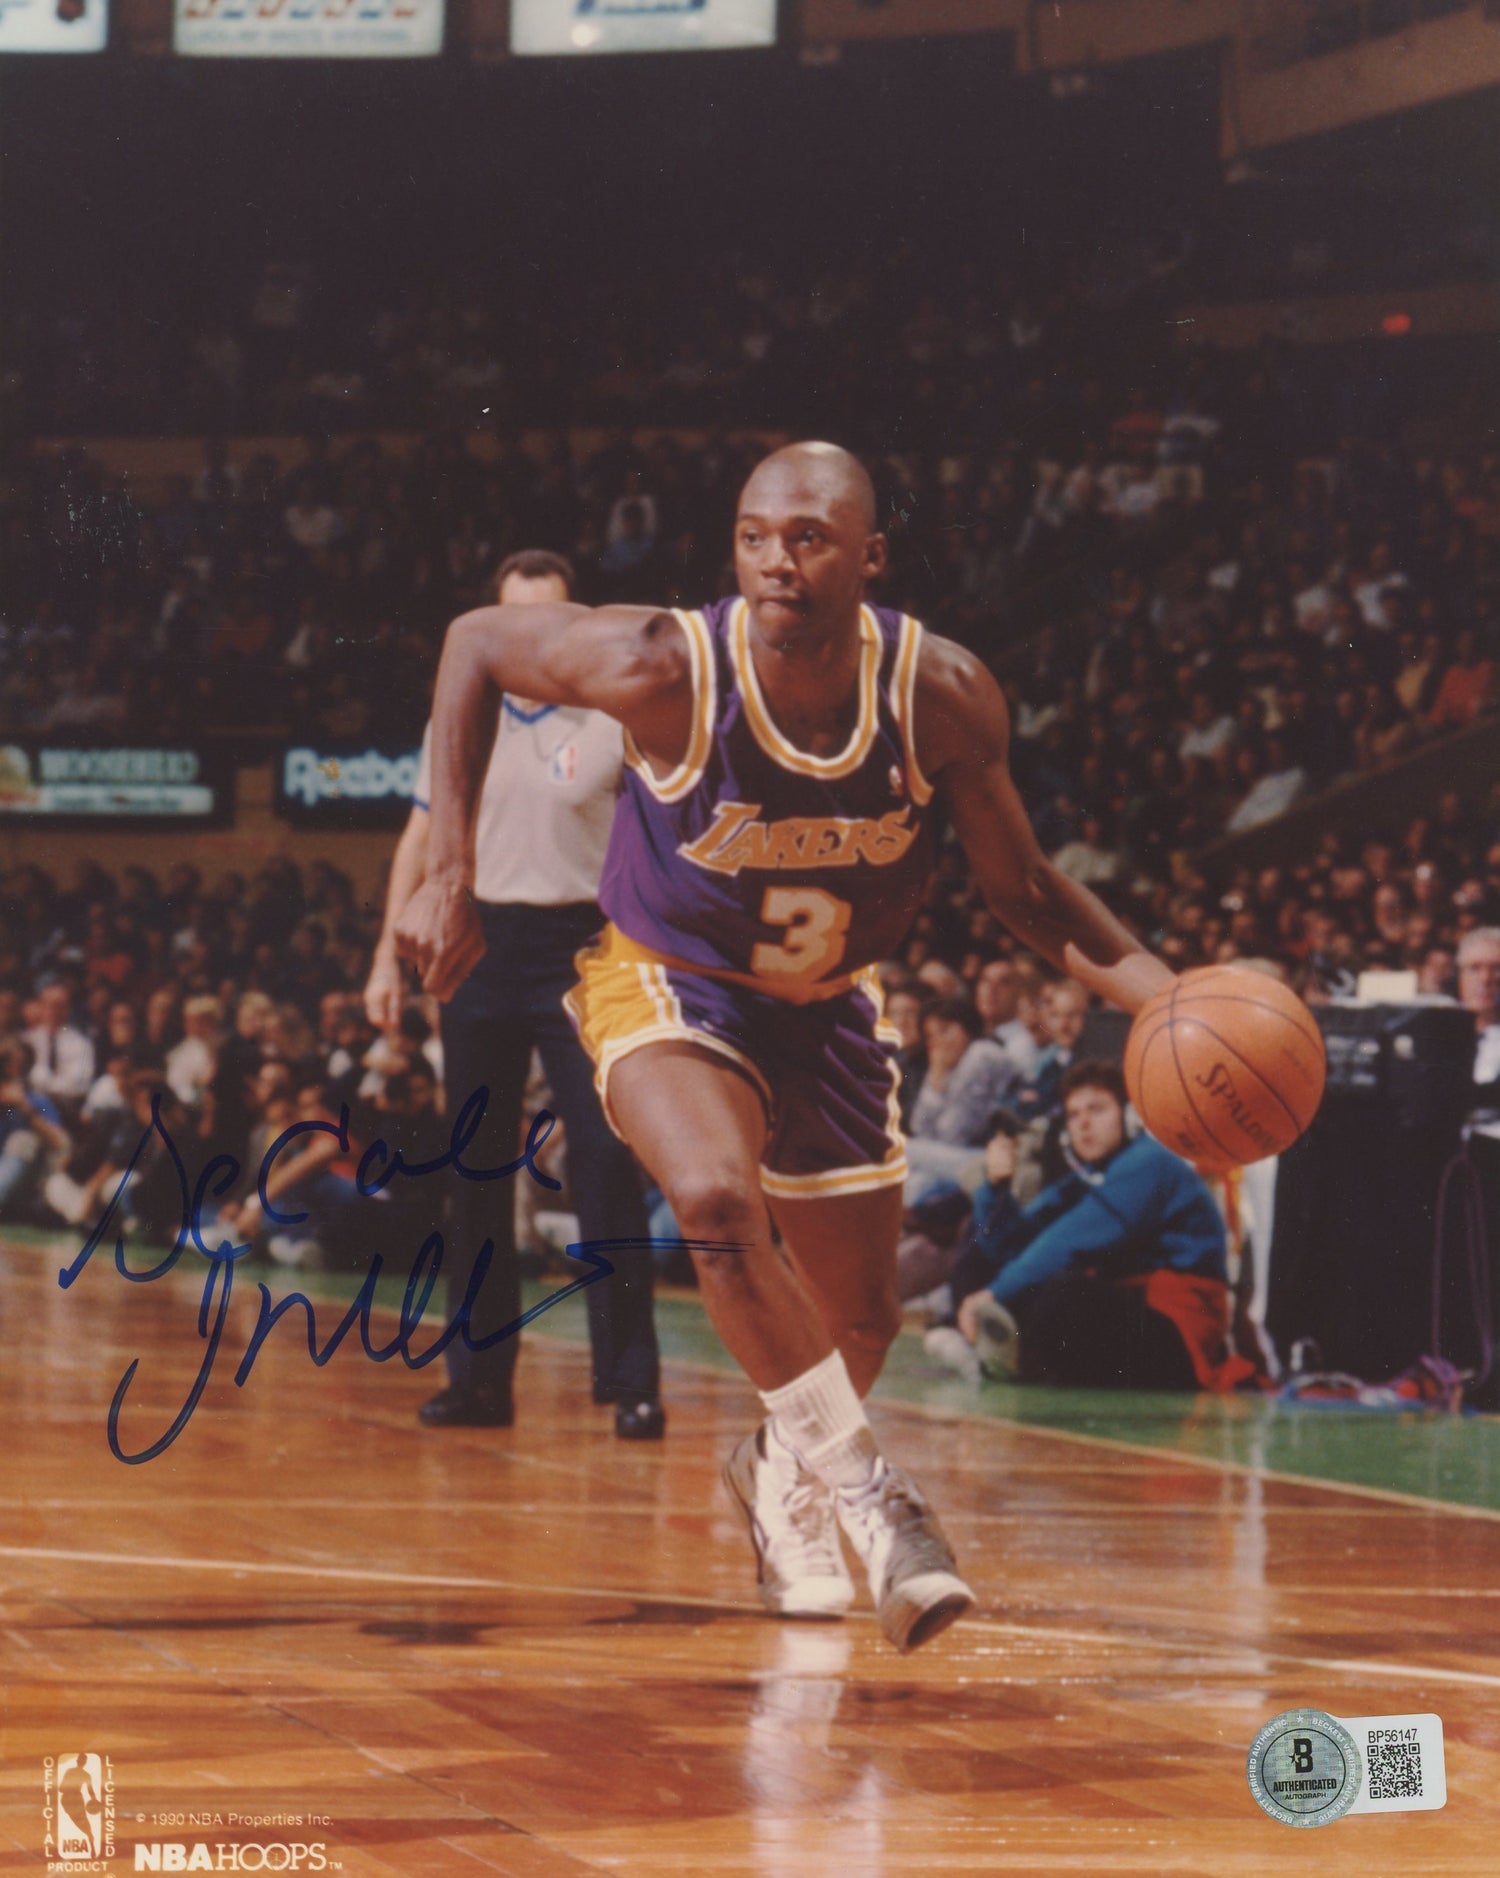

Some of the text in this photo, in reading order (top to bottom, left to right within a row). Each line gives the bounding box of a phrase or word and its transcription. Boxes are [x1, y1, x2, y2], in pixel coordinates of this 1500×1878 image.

[676, 800, 920, 877] LAKERS
[752, 886, 852, 979] 3
[1251, 1719, 1288, 1758] AUTHENTIC
[1368, 1728, 1418, 1743] BP56147
[1273, 1779, 1337, 1793] AUTHENTICATED
[1285, 1793, 1327, 1801] AUTOGRAPH
